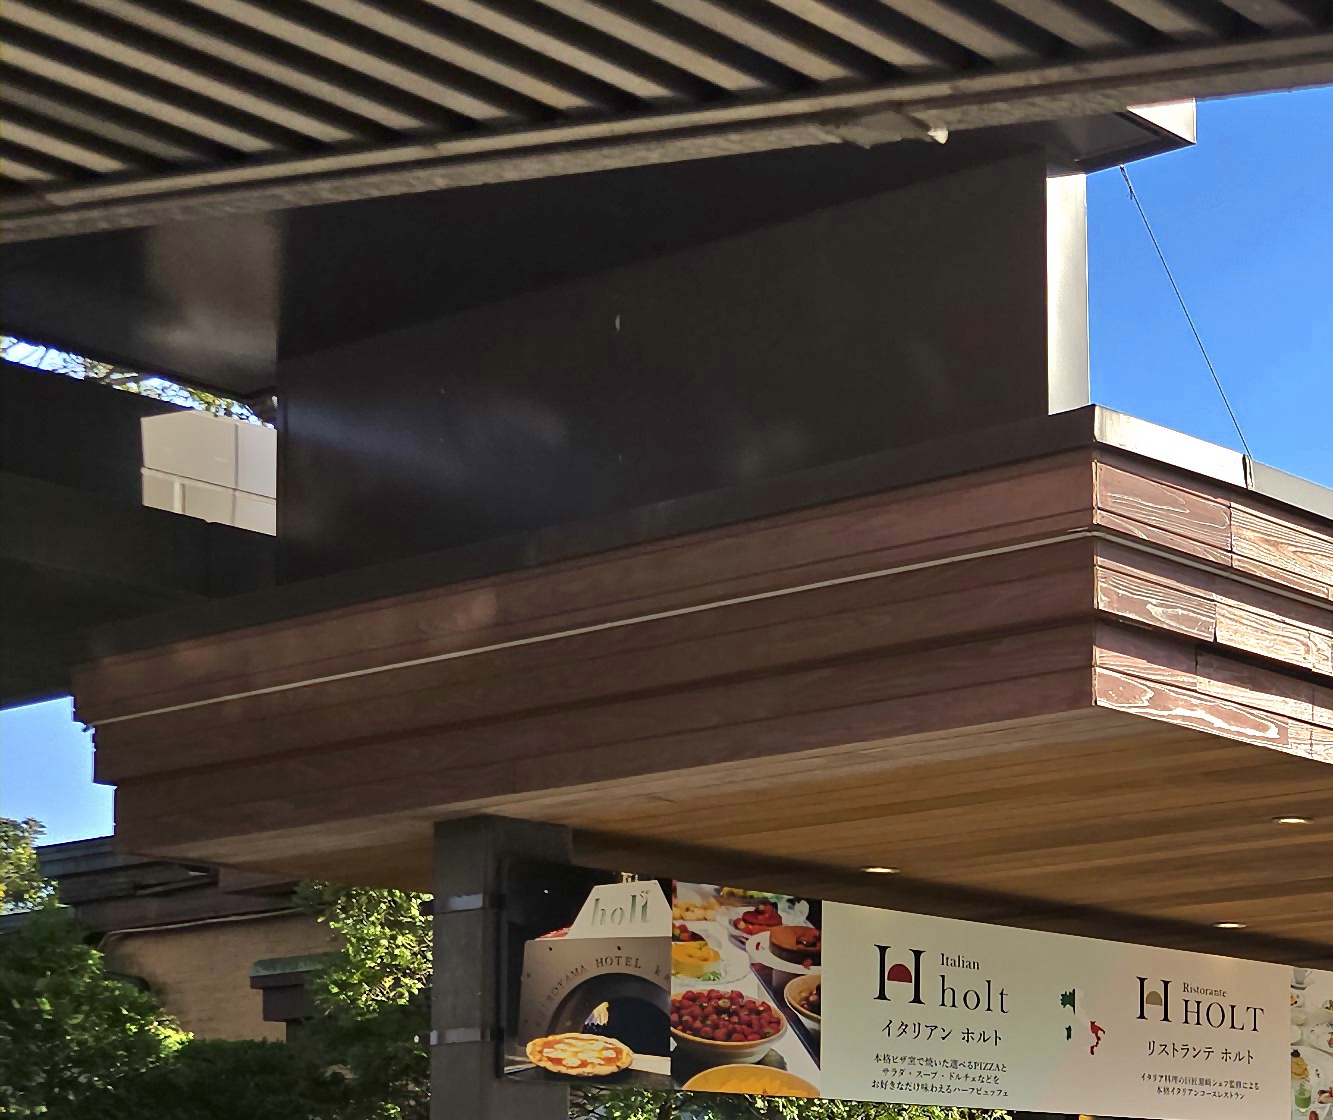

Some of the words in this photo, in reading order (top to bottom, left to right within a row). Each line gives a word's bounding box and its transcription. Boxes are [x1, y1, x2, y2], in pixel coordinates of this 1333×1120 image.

[595, 955, 642, 969] HOTEL
[940, 953, 980, 970] Italian
[939, 974, 1009, 1014] holt
[1182, 982, 1227, 998] Ristorante
[1182, 998, 1265, 1032] HOLT
[881, 1019, 953, 1041] イタリアン
[961, 1027, 1002, 1046] ホルト
[1147, 1040, 1215, 1061] リストランテ
[1220, 1047, 1254, 1064] ホルト
